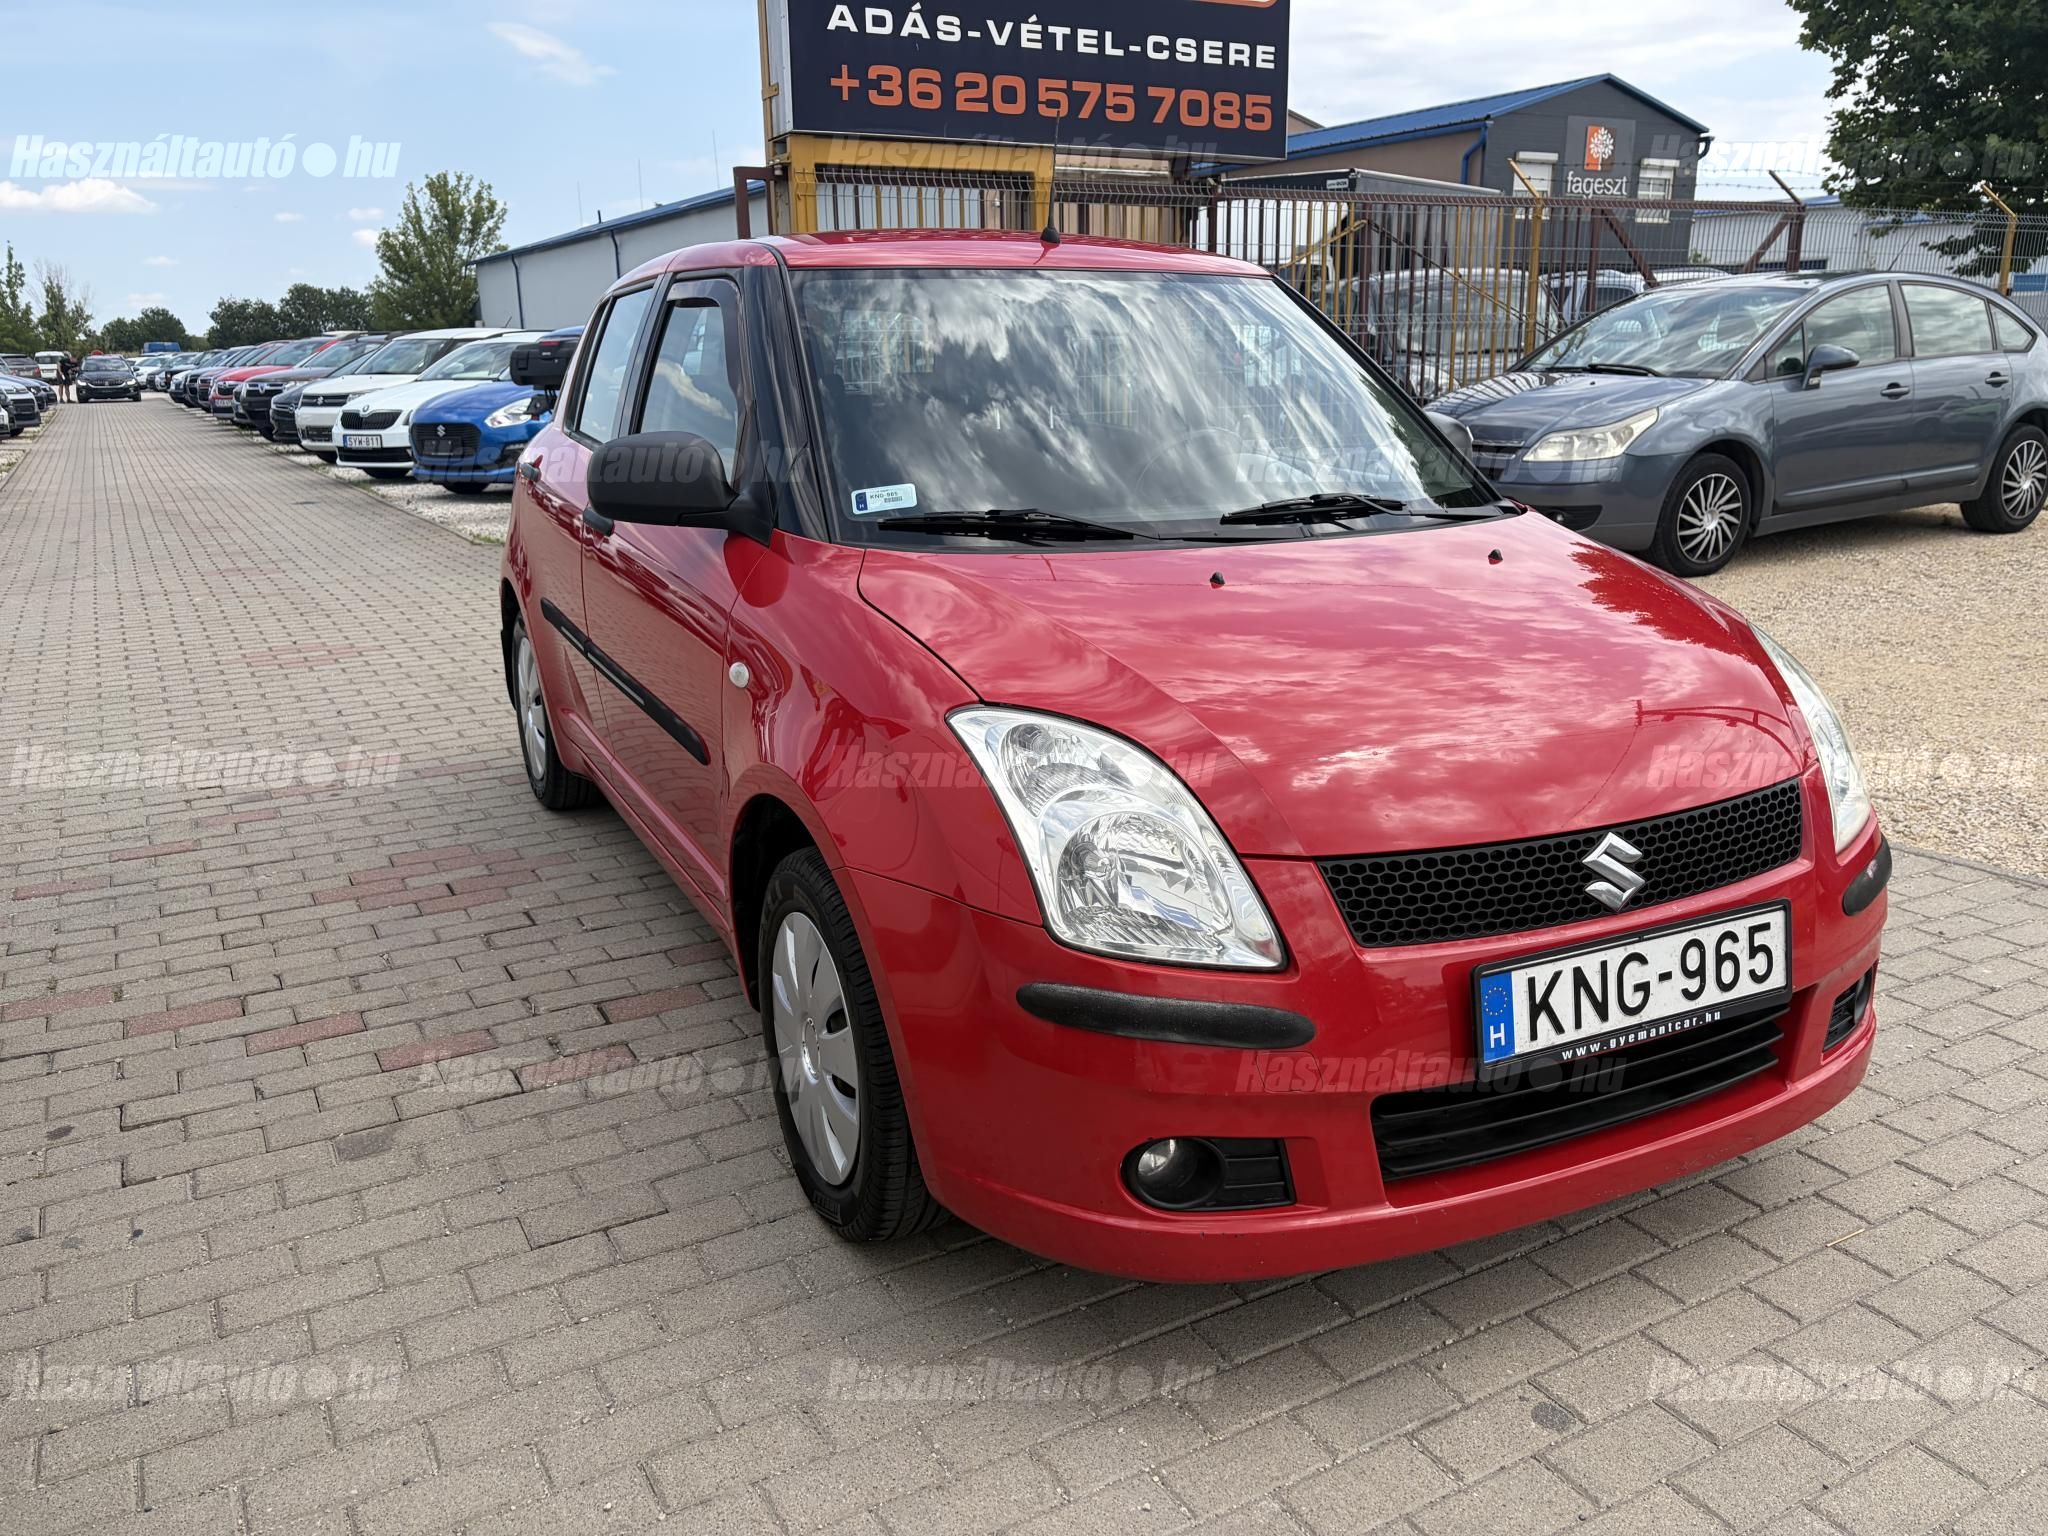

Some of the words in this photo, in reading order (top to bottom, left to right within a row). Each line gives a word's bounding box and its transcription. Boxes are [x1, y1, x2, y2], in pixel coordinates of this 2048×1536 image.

[826, 2, 1276, 69] ADÁS-VÉTEL-CSERE
[830, 64, 942, 110] +36
[955, 72, 1026, 115] 20
[1036, 78, 1136, 123] 575
[1147, 86, 1272, 131] 7085
[1567, 171, 1627, 199] fageszt
[1527, 921, 1775, 1042] KNG-965
[1489, 1024, 1506, 1049] H
[1562, 1010, 1721, 1060] www.gyemantcar.hu
